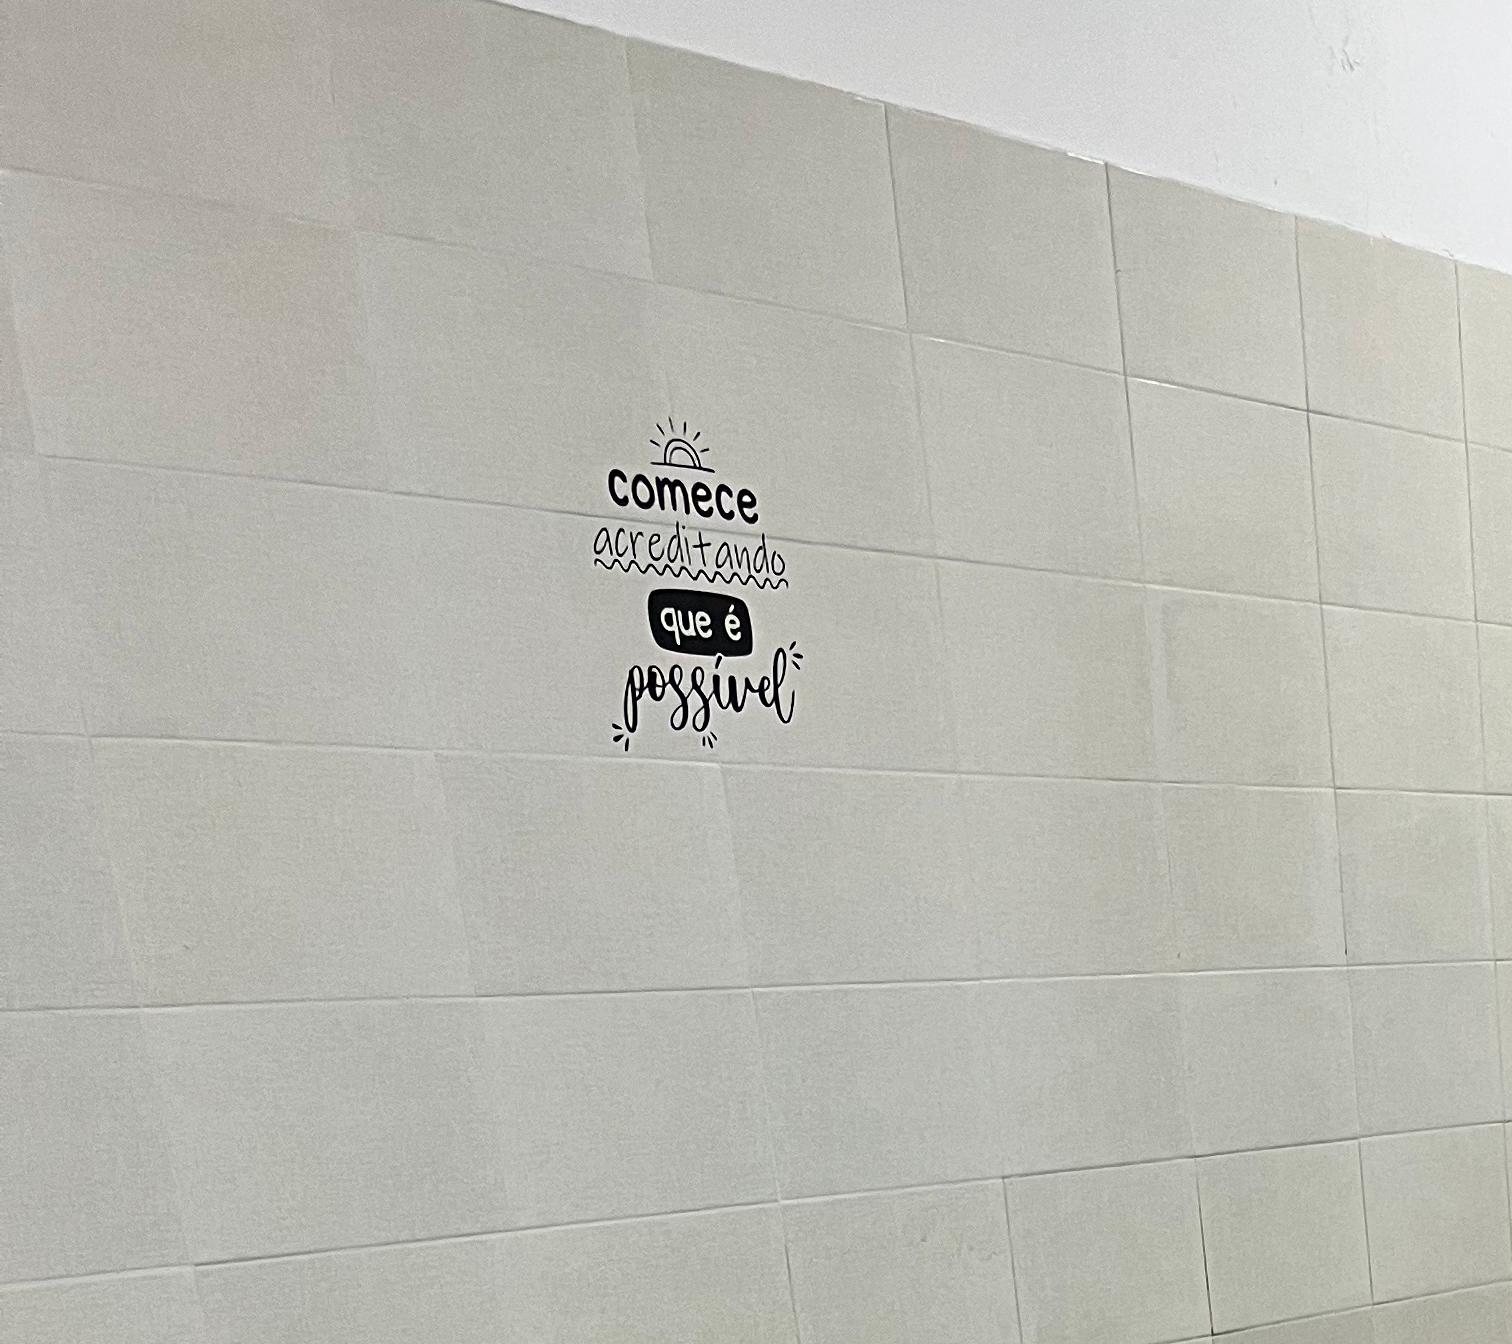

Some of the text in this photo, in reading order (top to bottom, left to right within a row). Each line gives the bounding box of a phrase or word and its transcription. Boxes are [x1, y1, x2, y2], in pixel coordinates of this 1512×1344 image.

[608, 469, 758, 524] comece
[594, 521, 785, 576] acreditando
[661, 605, 742, 645] que é
[624, 647, 795, 733] possível
